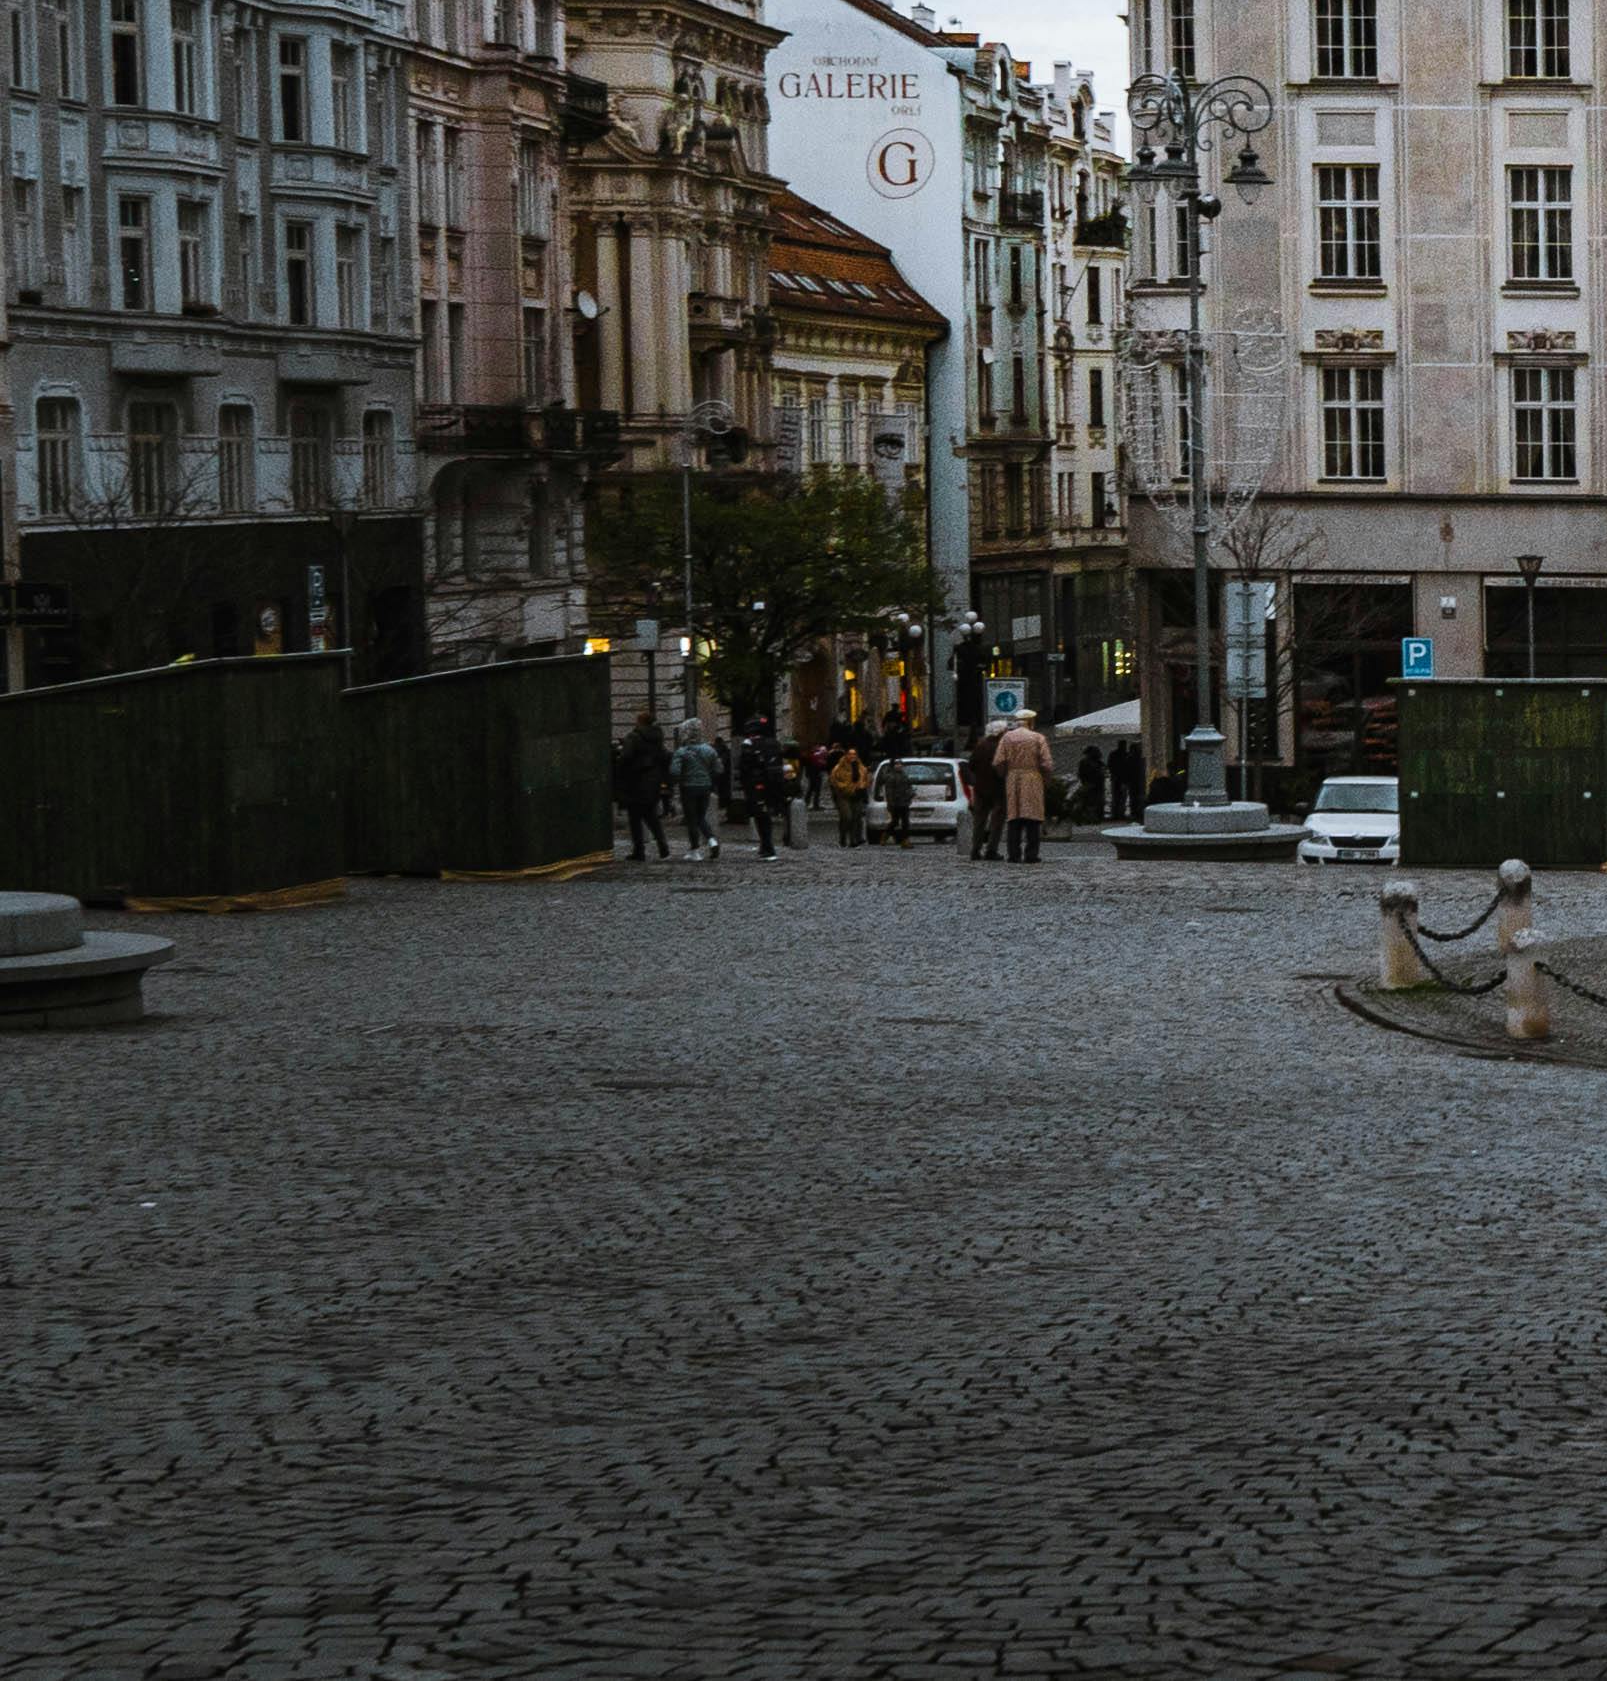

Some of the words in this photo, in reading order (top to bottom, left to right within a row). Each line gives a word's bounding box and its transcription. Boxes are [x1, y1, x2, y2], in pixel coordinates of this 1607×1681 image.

[778, 72, 920, 100] GALERIE
[878, 141, 918, 186] G
[1409, 642, 1427, 666] P
